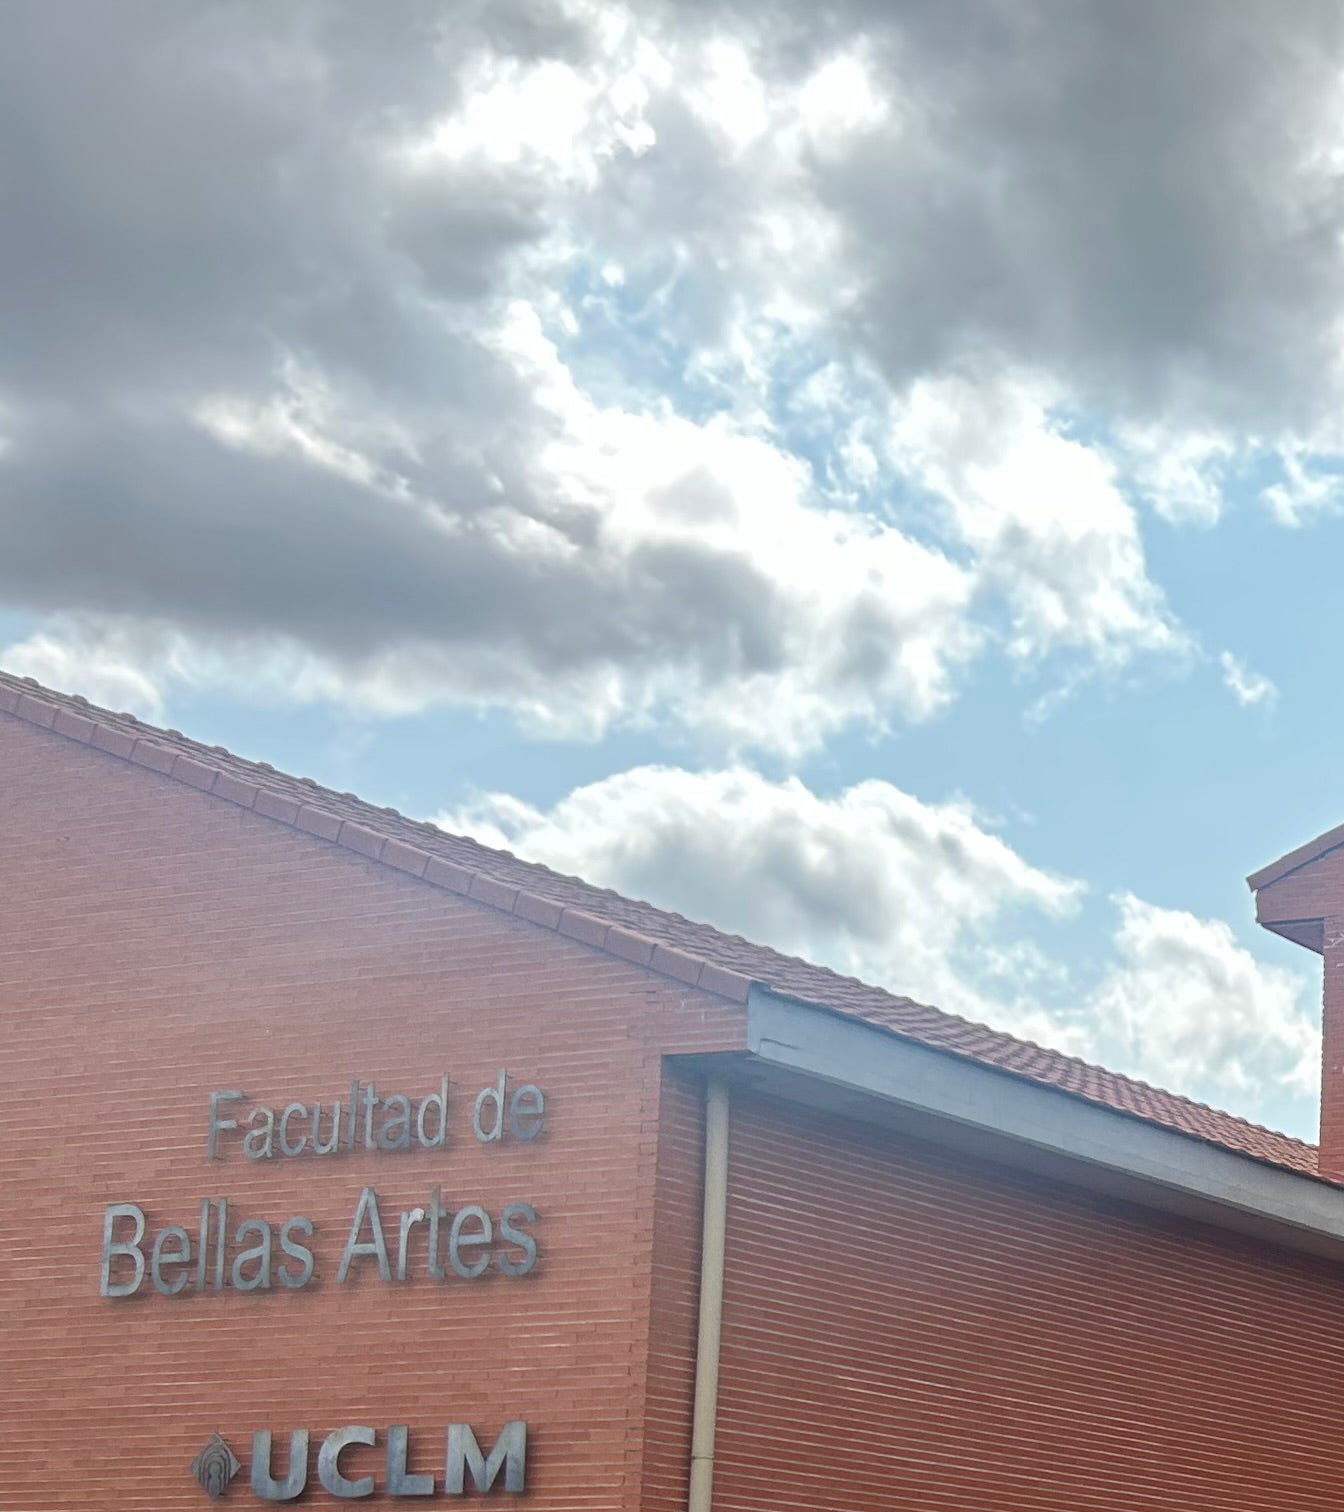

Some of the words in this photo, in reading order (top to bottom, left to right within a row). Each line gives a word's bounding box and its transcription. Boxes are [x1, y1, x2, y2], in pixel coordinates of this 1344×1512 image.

[208, 1072, 450, 1160] Facultad
[473, 1068, 546, 1143] de
[100, 1196, 316, 1298] Bellas
[337, 1185, 539, 1284] Artes
[250, 1421, 529, 1500] UCLM
